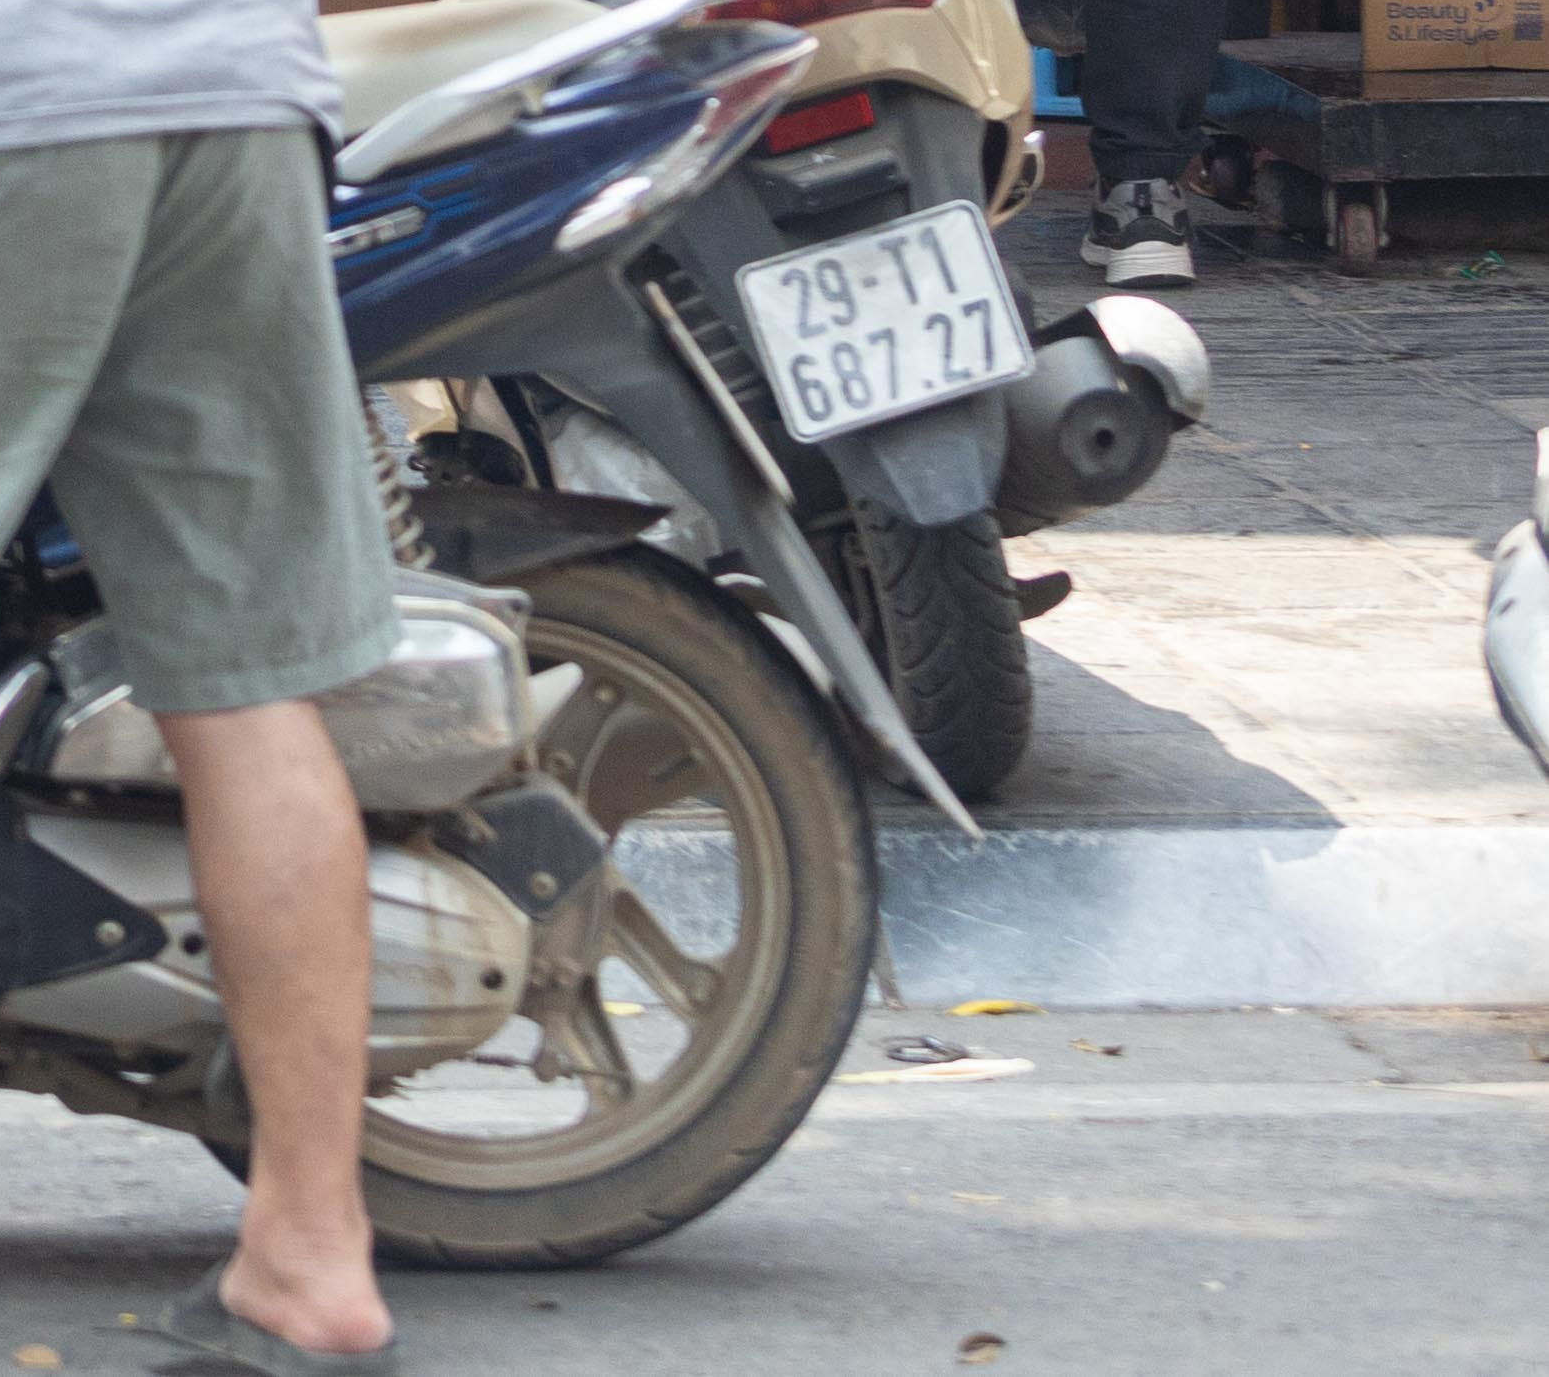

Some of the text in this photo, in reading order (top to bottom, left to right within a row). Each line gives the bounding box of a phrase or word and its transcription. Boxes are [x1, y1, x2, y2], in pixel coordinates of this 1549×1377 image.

[1386, 2, 1469, 24] Beauty
[779, 227, 962, 339] 29-T1
[789, 297, 1001, 425] 687.27
